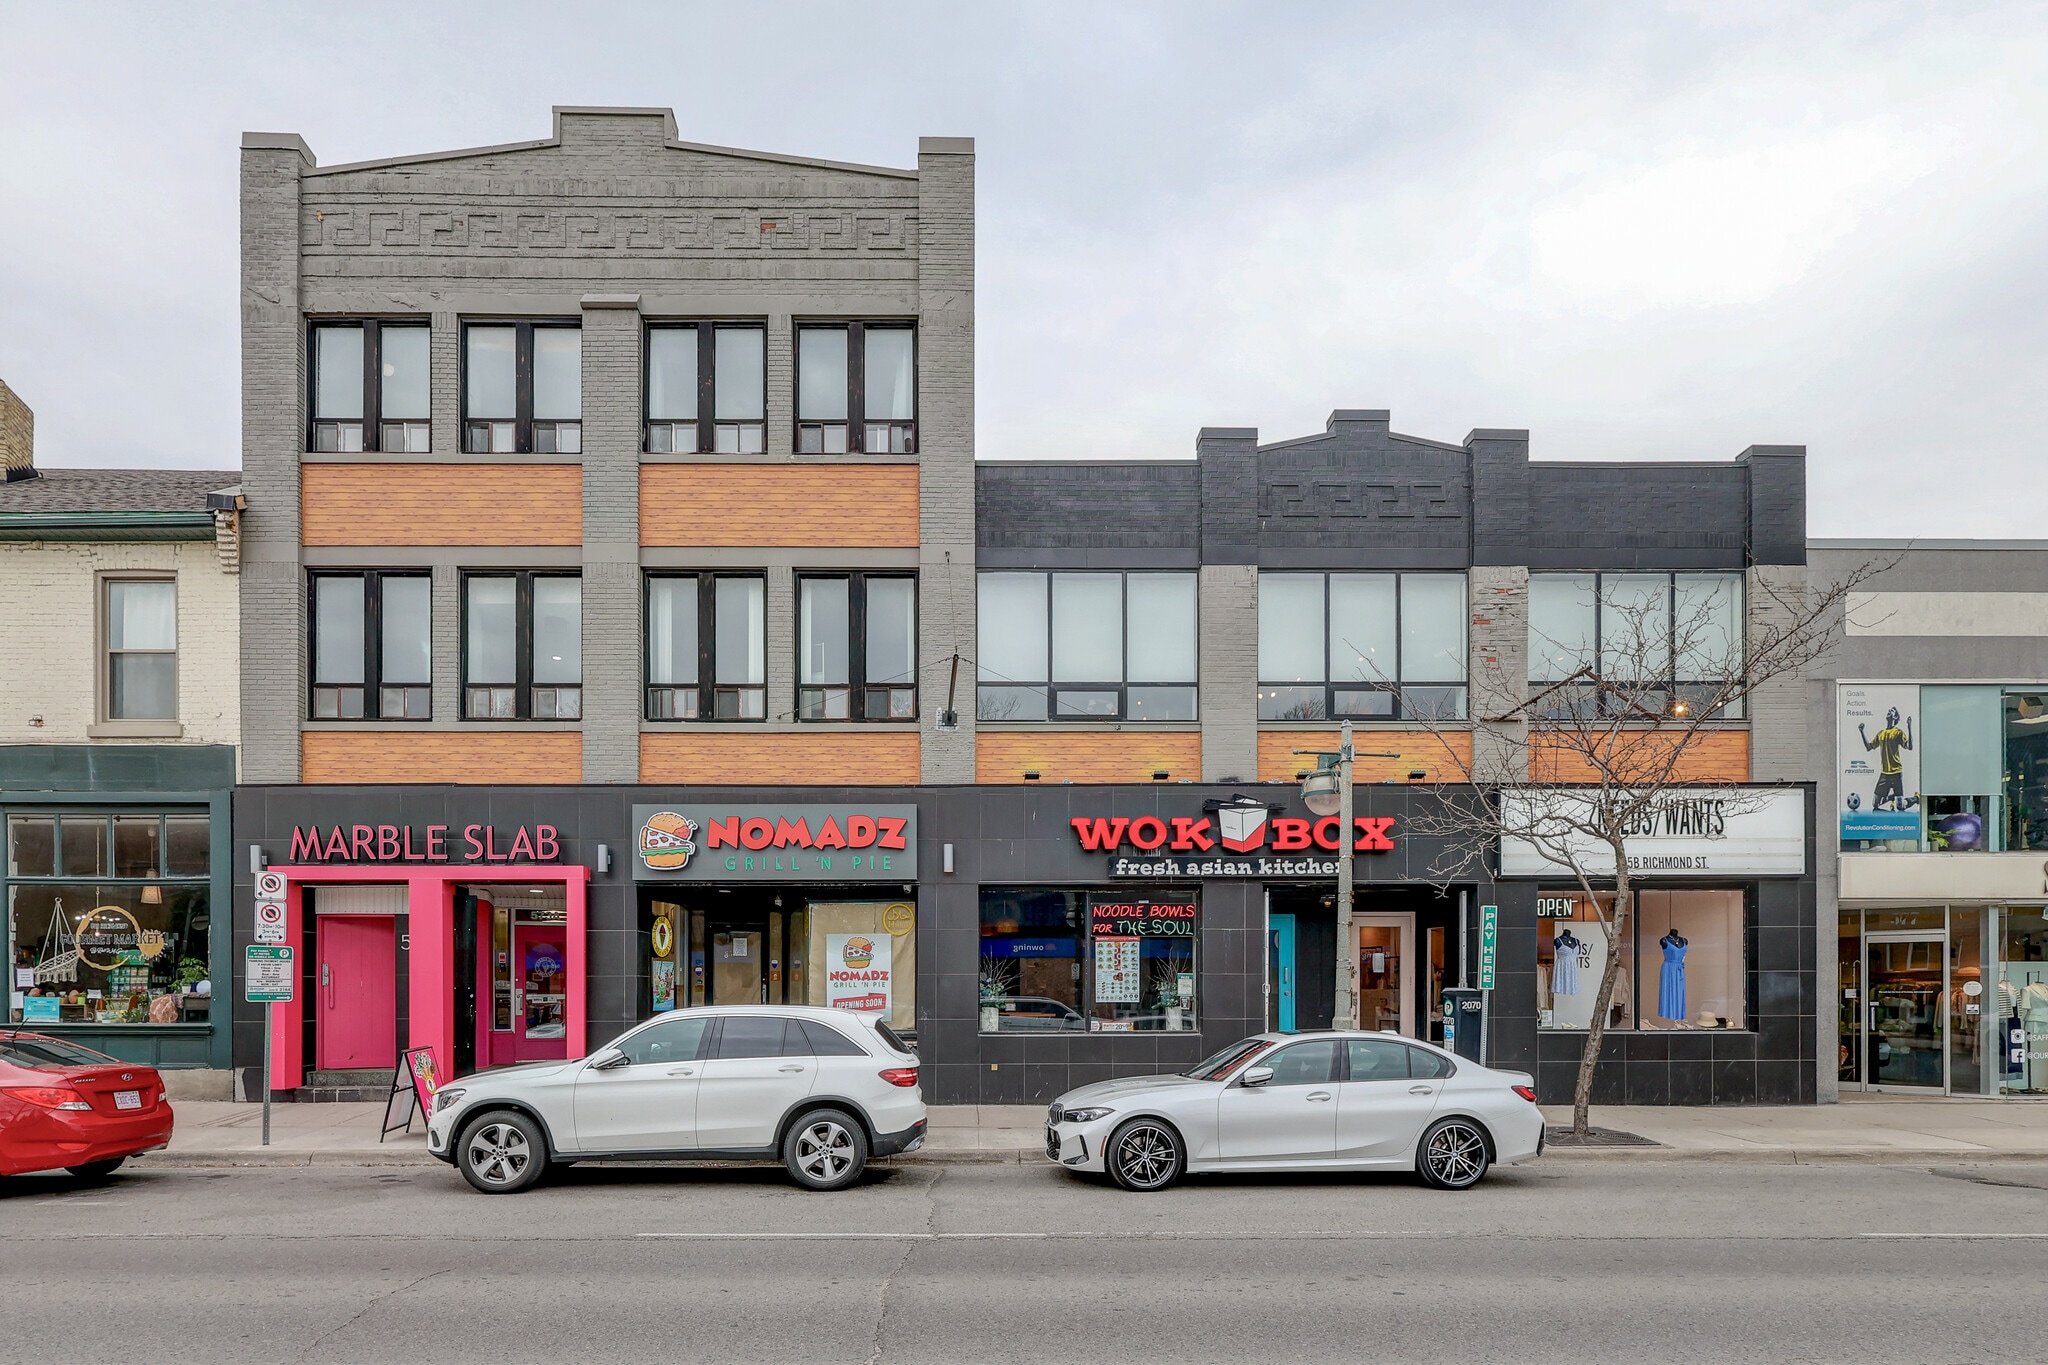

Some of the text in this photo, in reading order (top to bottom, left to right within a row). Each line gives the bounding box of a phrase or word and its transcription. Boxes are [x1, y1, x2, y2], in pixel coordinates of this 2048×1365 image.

[707, 814, 909, 851] NOMADZ
[1071, 816, 1396, 852] WOK BOX
[1845, 824, 1916, 832] RevolutionConditioning.com
[289, 824, 561, 861] MARBLE SLAB
[725, 855, 801, 871] GRILL
[852, 855, 892, 871] PIE
[1115, 857, 1181, 876] fresh
[1186, 858, 1253, 876] asian
[1643, 856, 1693, 869] RICHMOND
[1093, 904, 1196, 918] NOODLE BOWLS
[1537, 898, 1573, 917] OPEN
[1092, 919, 1194, 936] FOR THE SOUL
[1483, 912, 1496, 983] PAY HERE
[829, 970, 889, 982] NOMADZ
[836, 997, 883, 1009] OPENING SOON
[1461, 1001, 1482, 1010] 2070
